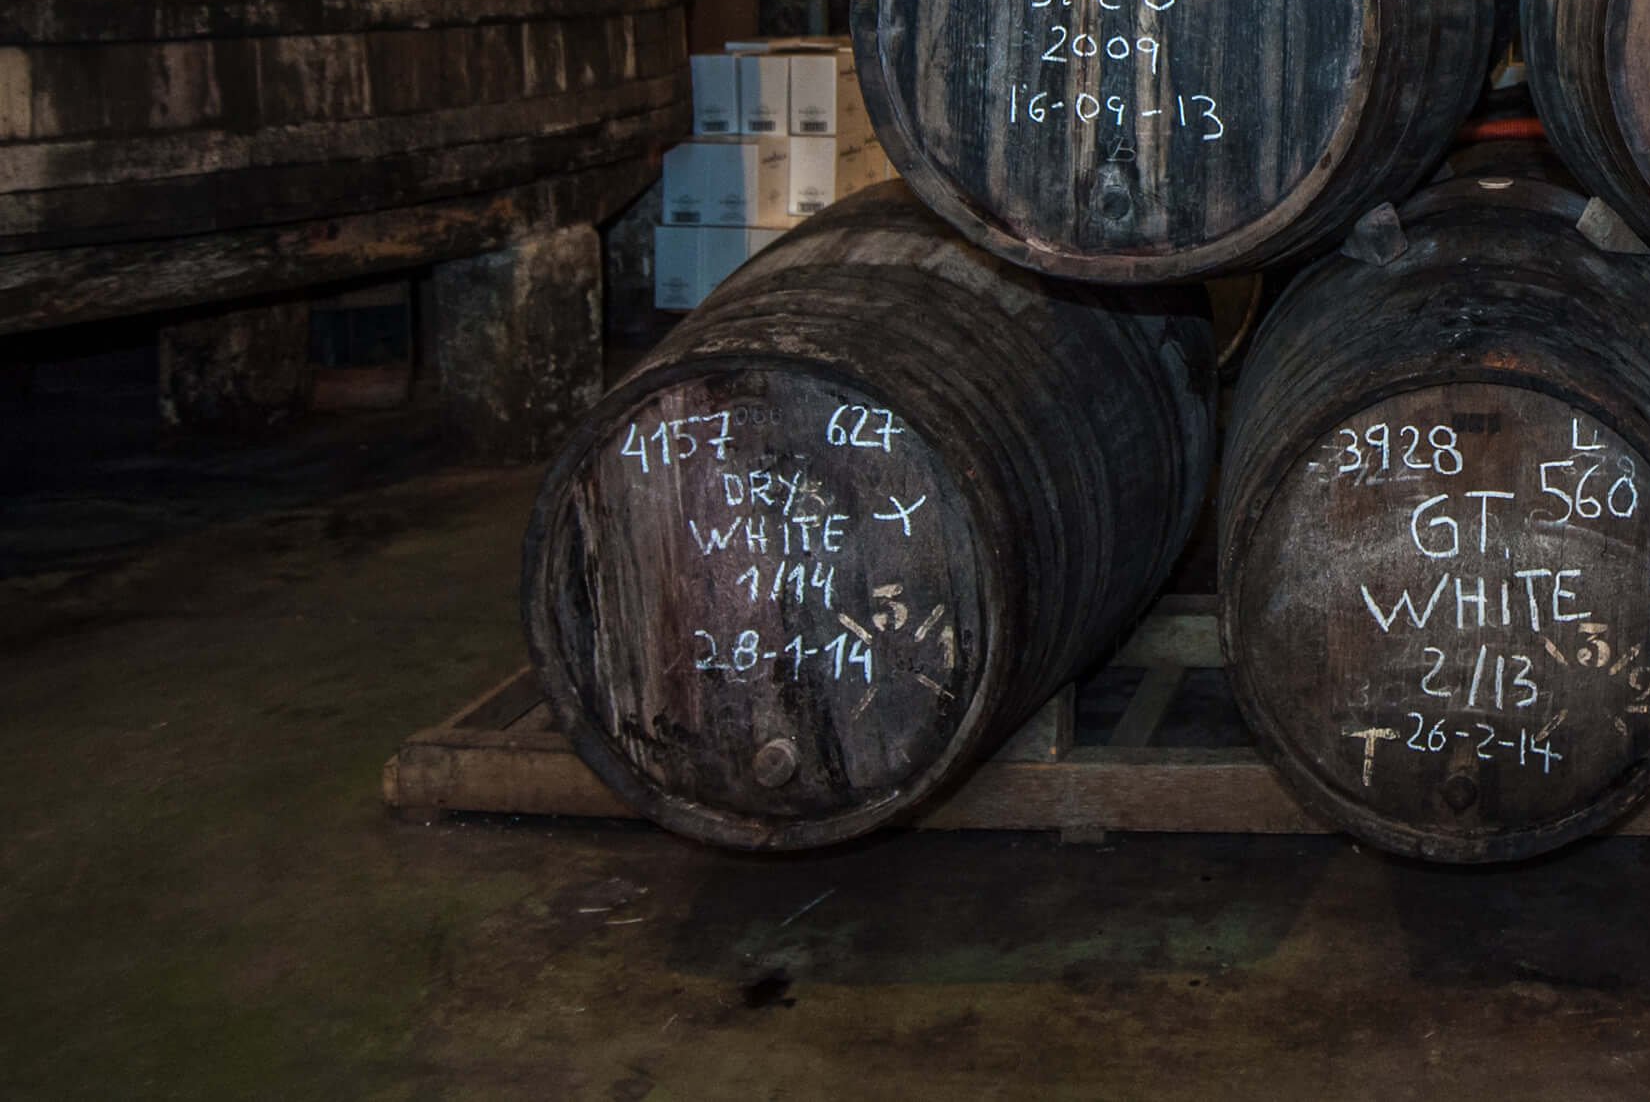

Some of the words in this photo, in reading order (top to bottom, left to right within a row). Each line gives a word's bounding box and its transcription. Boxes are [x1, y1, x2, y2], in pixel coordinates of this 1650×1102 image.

[1041, 25, 1160, 74] 2009
[1009, 84, 1224, 140] 16-09-13
[619, 410, 734, 473] 4157
[826, 404, 904, 453] 627
[723, 470, 800, 516] DRY
[1338, 422, 1463, 475] 3928
[1539, 460, 1638, 524] 560
[689, 514, 851, 555] WHITE
[736, 560, 834, 611] 1/14
[1361, 569, 1592, 633] WHITE
[695, 629, 872, 683] 28-1-14
[1421, 644, 1538, 710] 2/13
[1406, 712, 1563, 773] 26-2-14
